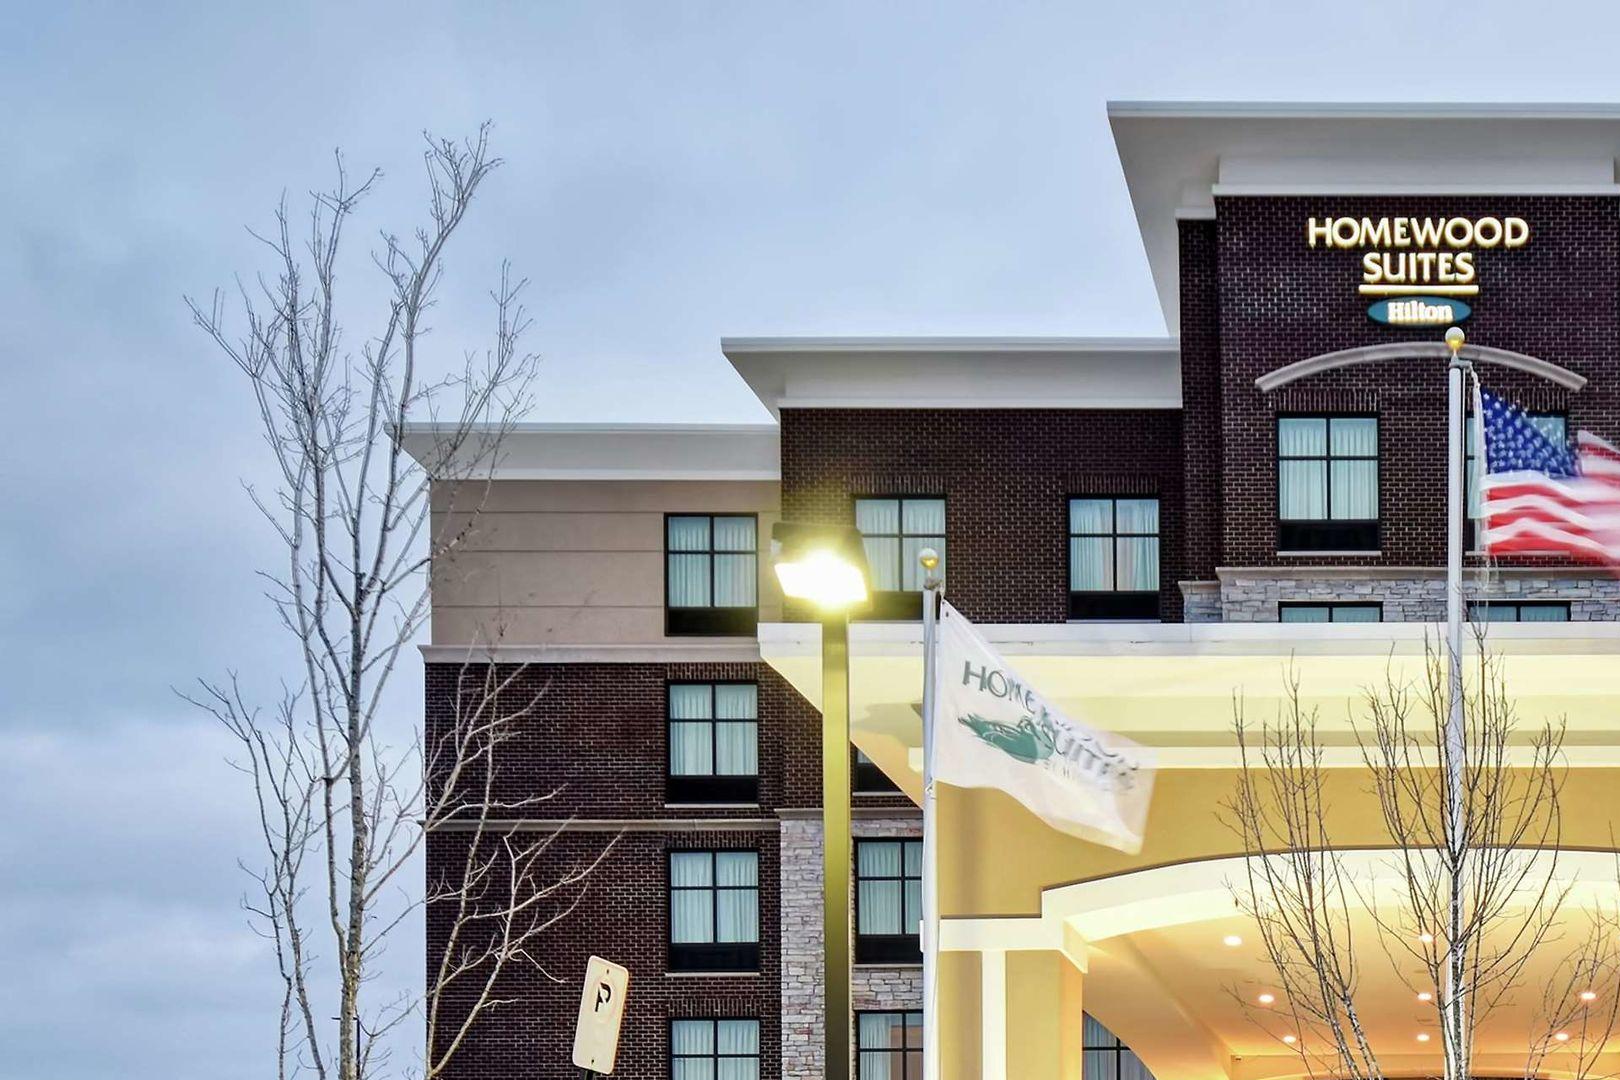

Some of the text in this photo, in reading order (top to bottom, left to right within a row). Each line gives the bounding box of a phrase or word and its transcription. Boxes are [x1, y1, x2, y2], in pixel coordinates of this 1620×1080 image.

[1308, 217, 1529, 248] HOMEWOOD
[1363, 252, 1475, 283] SUITES
[1387, 300, 1453, 324] Hilton
